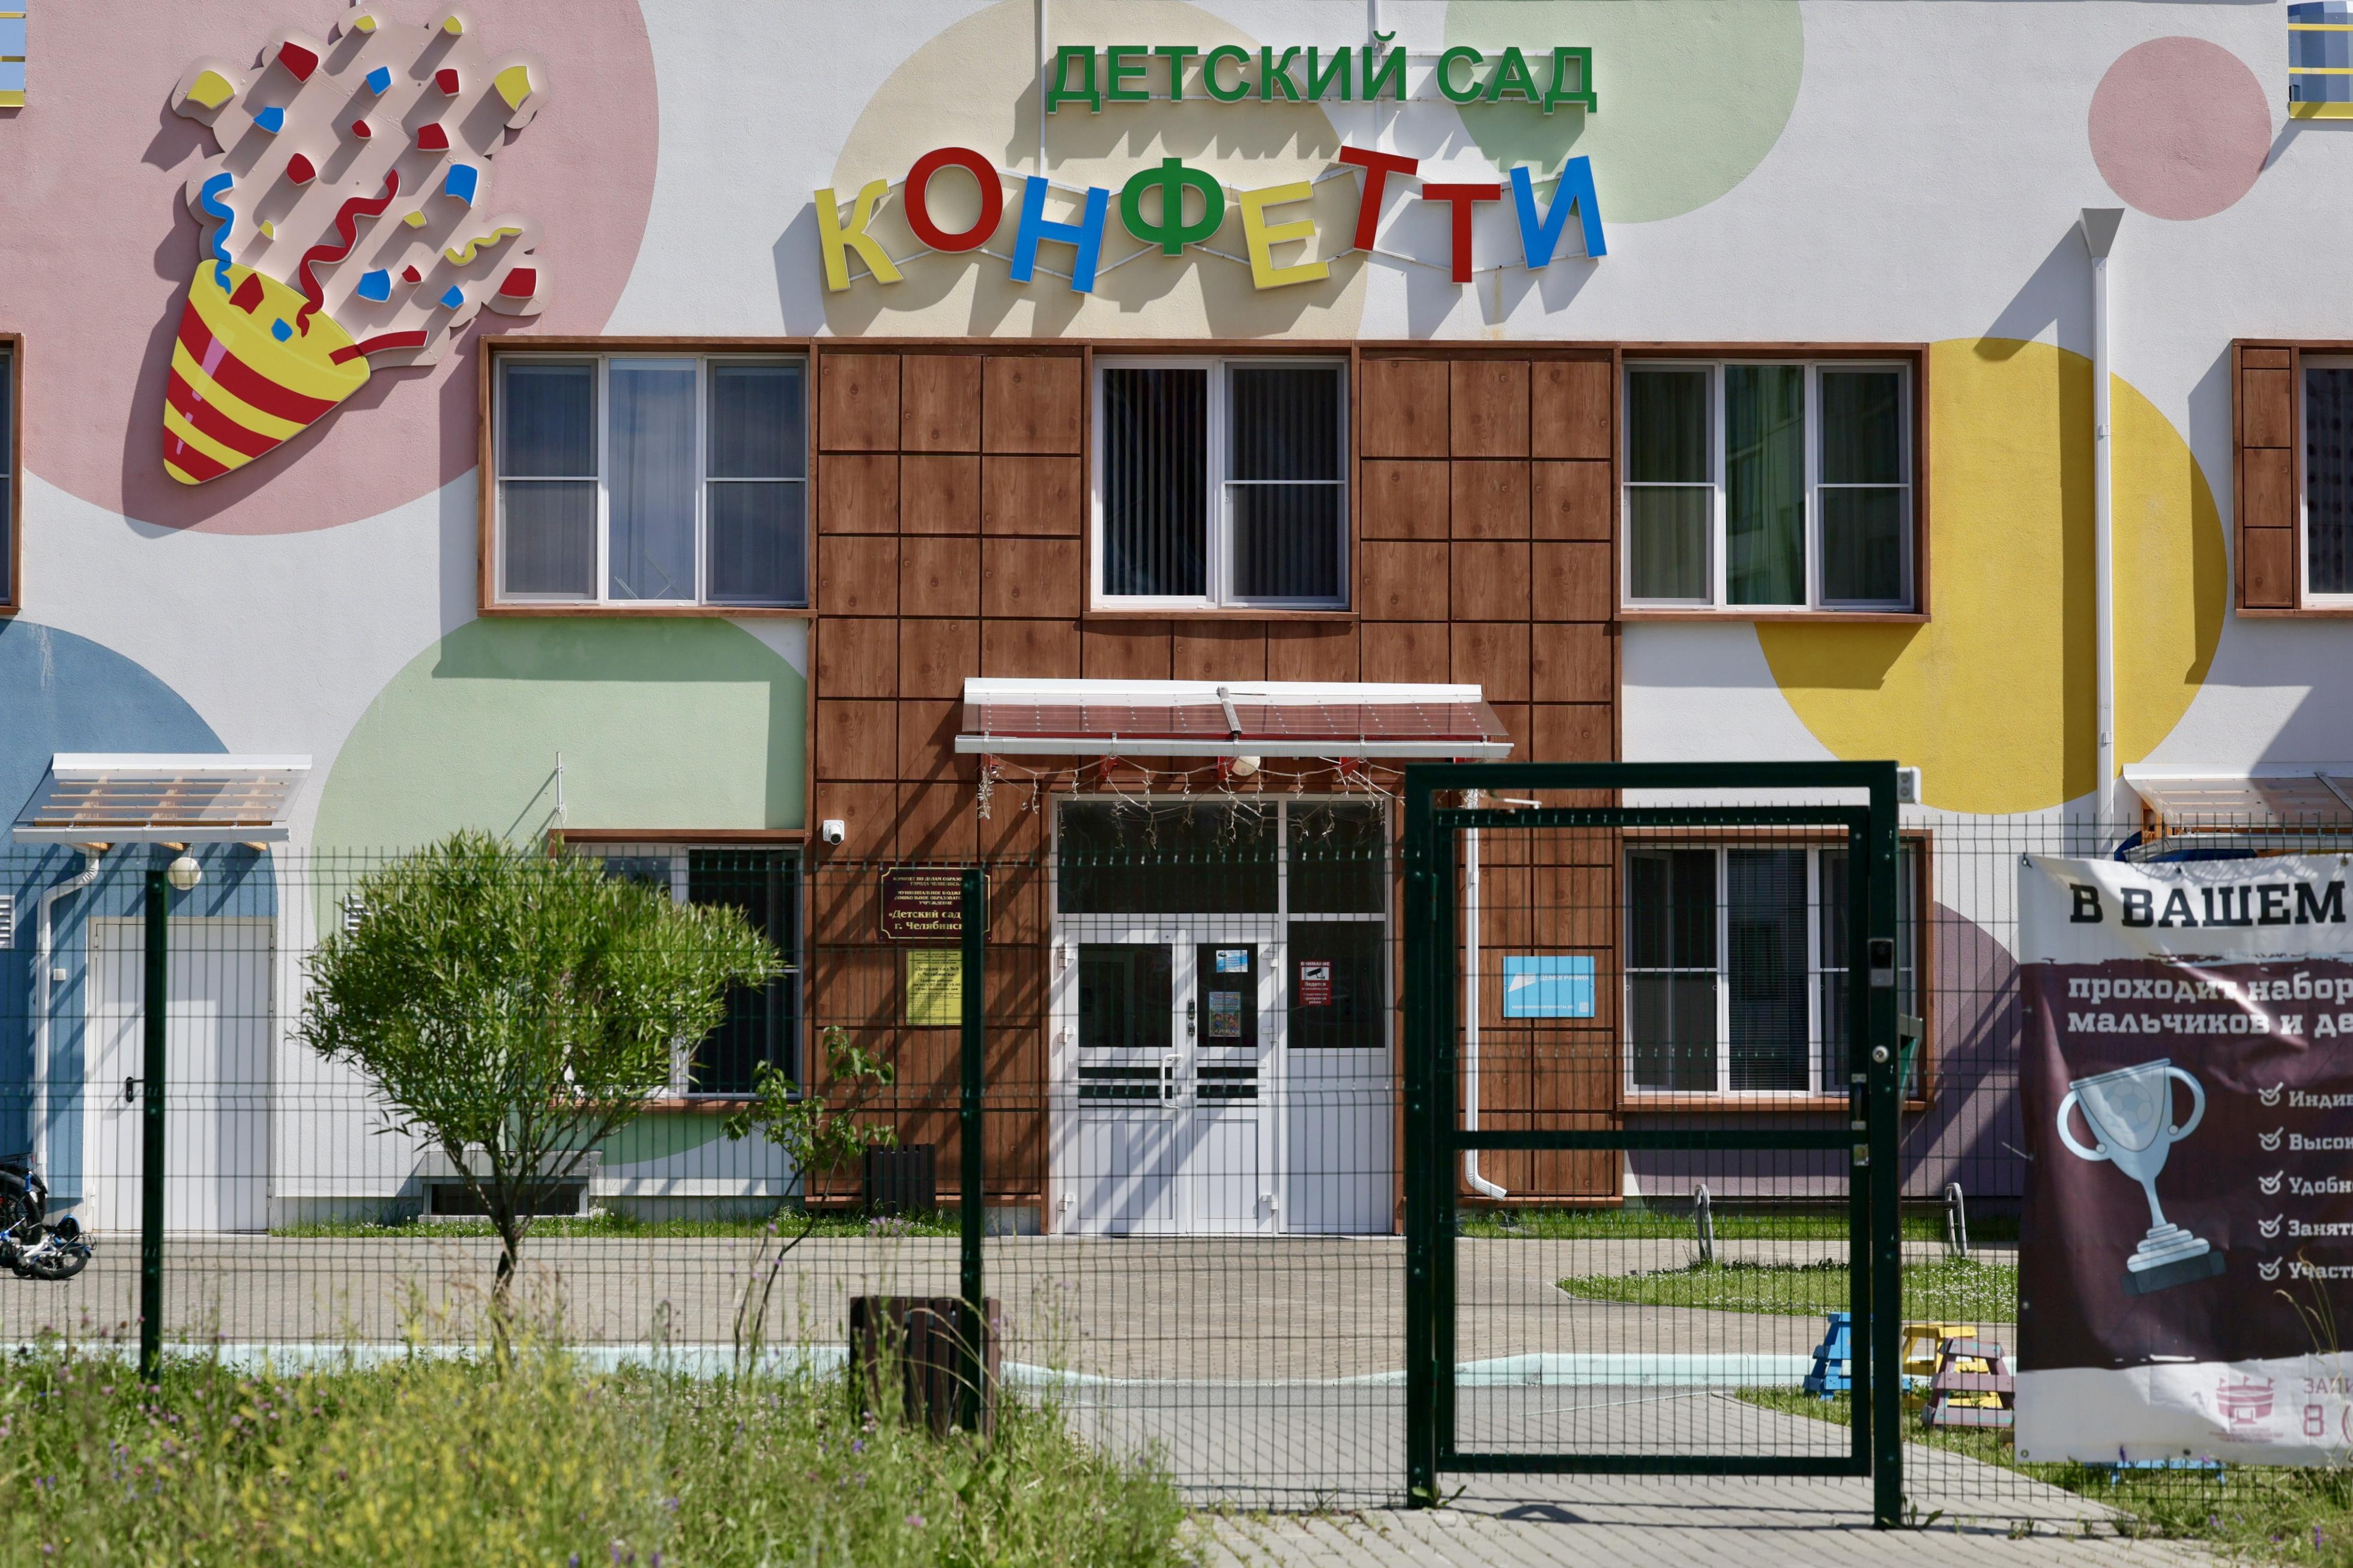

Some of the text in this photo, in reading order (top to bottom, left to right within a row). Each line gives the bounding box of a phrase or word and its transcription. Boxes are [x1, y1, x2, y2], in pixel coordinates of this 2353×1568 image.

[1047, 31, 1598, 114] ДЕТСКИЙ САД
[814, 146, 1607, 293] КОНФЕТТИ
[889, 910, 939, 919] «Детский
[2069, 881, 2346, 927] В ВАШЕМ
[2068, 971, 2353, 1004] проходит набор
[2068, 1012, 2353, 1039] мальчиков и де
[2303, 1404, 2324, 1437] 8
